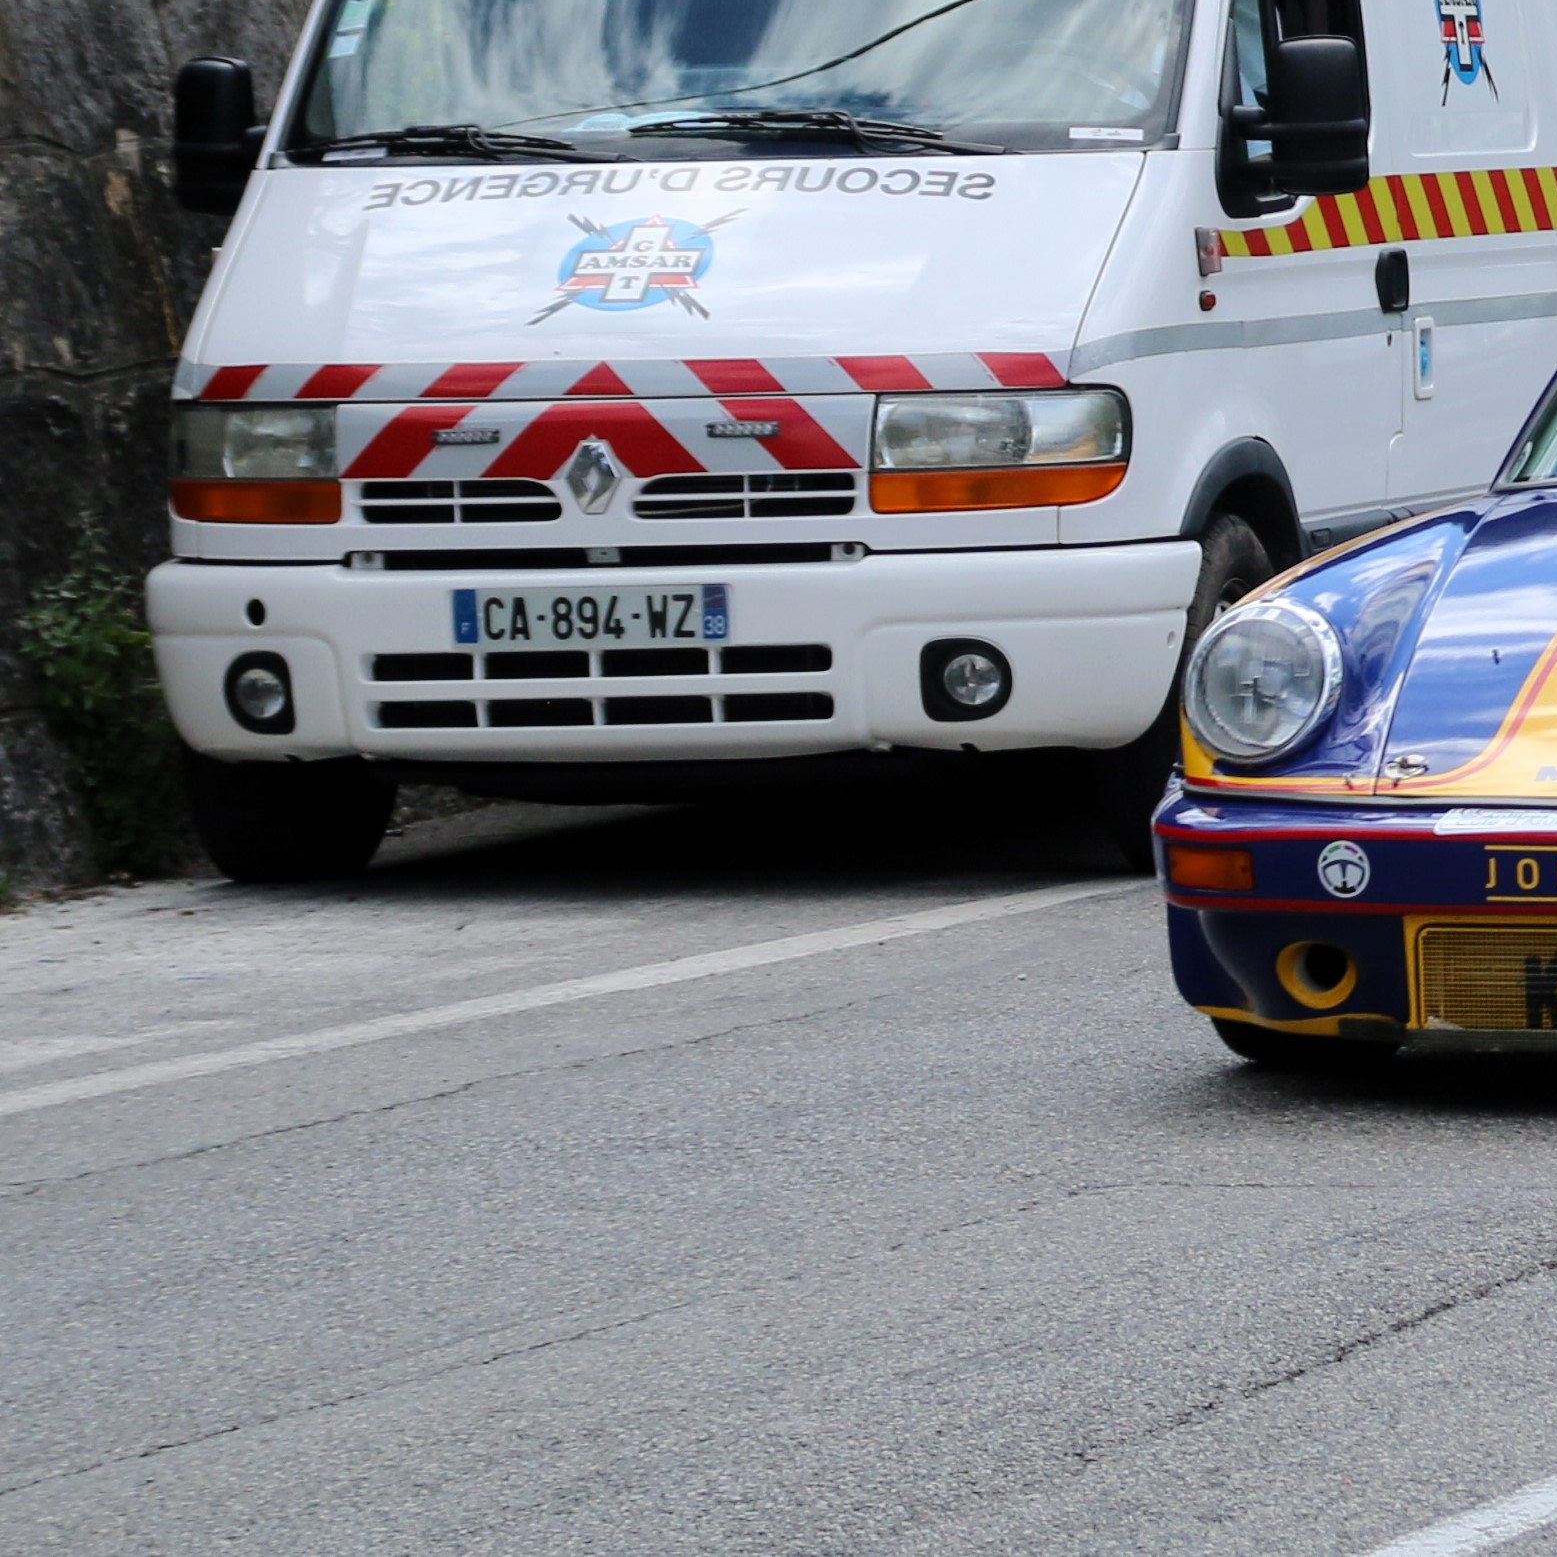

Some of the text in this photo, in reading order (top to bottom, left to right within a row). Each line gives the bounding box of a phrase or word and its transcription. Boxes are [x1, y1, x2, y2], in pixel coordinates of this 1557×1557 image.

[582, 252, 694, 271] AMSAR
[483, 593, 696, 641] CA-894-WZ
[703, 615, 726, 635] 38
[461, 622, 472, 634] F
